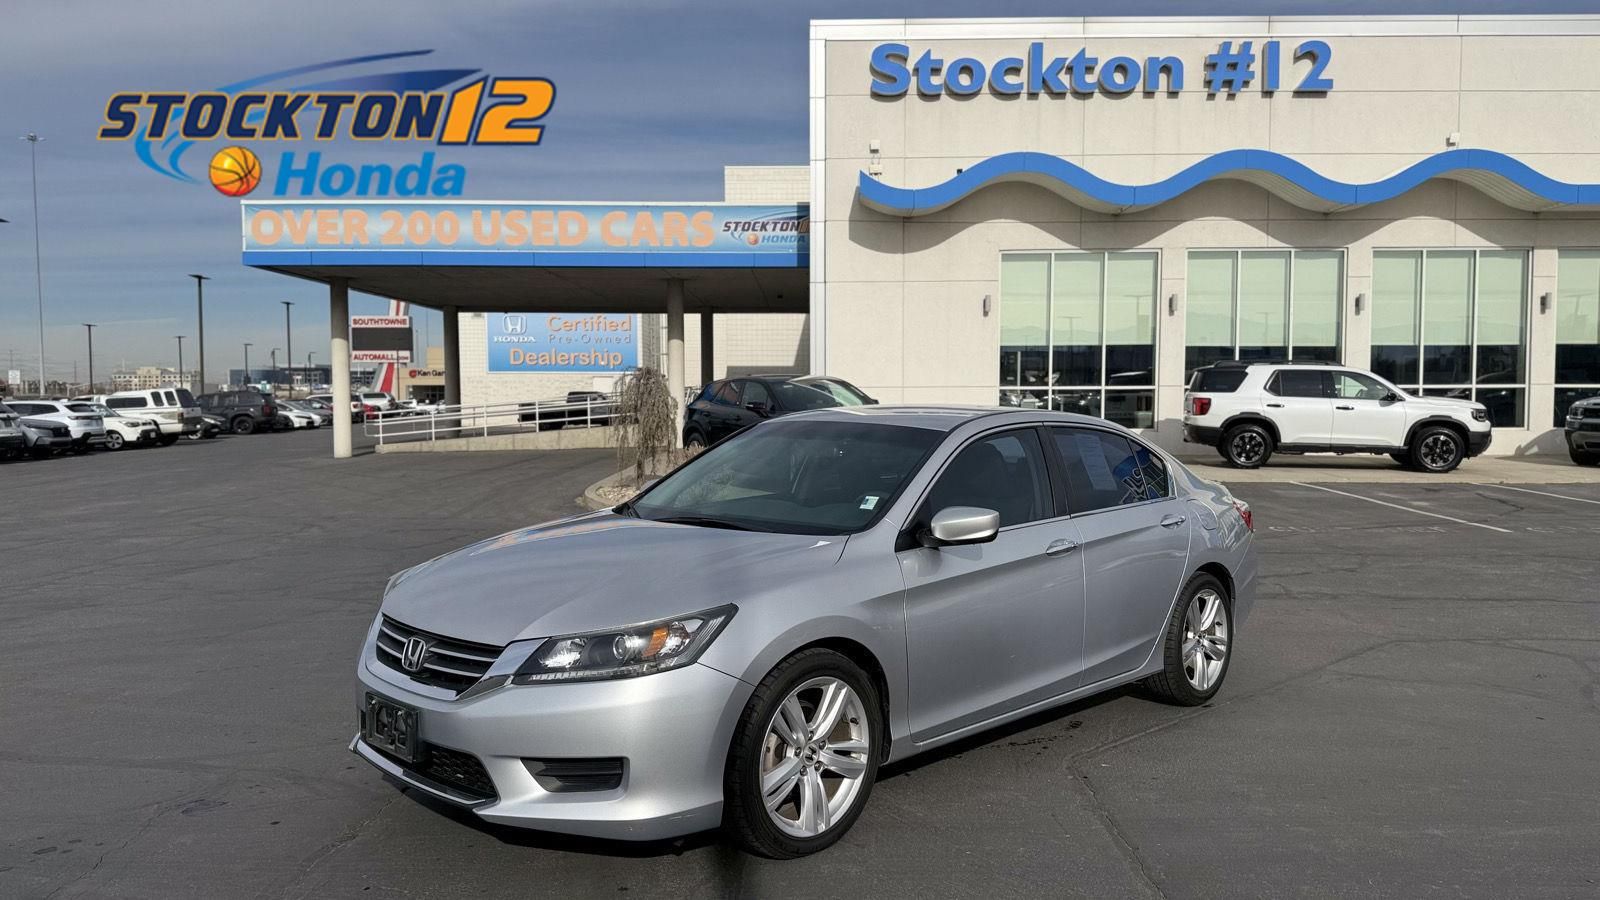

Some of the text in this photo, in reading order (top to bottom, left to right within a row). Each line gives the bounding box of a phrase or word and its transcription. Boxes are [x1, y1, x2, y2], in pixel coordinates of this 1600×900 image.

[869, 40, 1334, 95] Stockton #12
[251, 208, 715, 248] OVER 200 USED CARS
[761, 234, 806, 243] HONDA
[352, 318, 408, 326] SOUTHTOWNE
[546, 315, 632, 332] Certified
[493, 335, 536, 343] HONDA
[548, 333, 632, 344] Pre-Owned
[509, 347, 623, 368] Dealership
[417, 369, 431, 377] Ken
